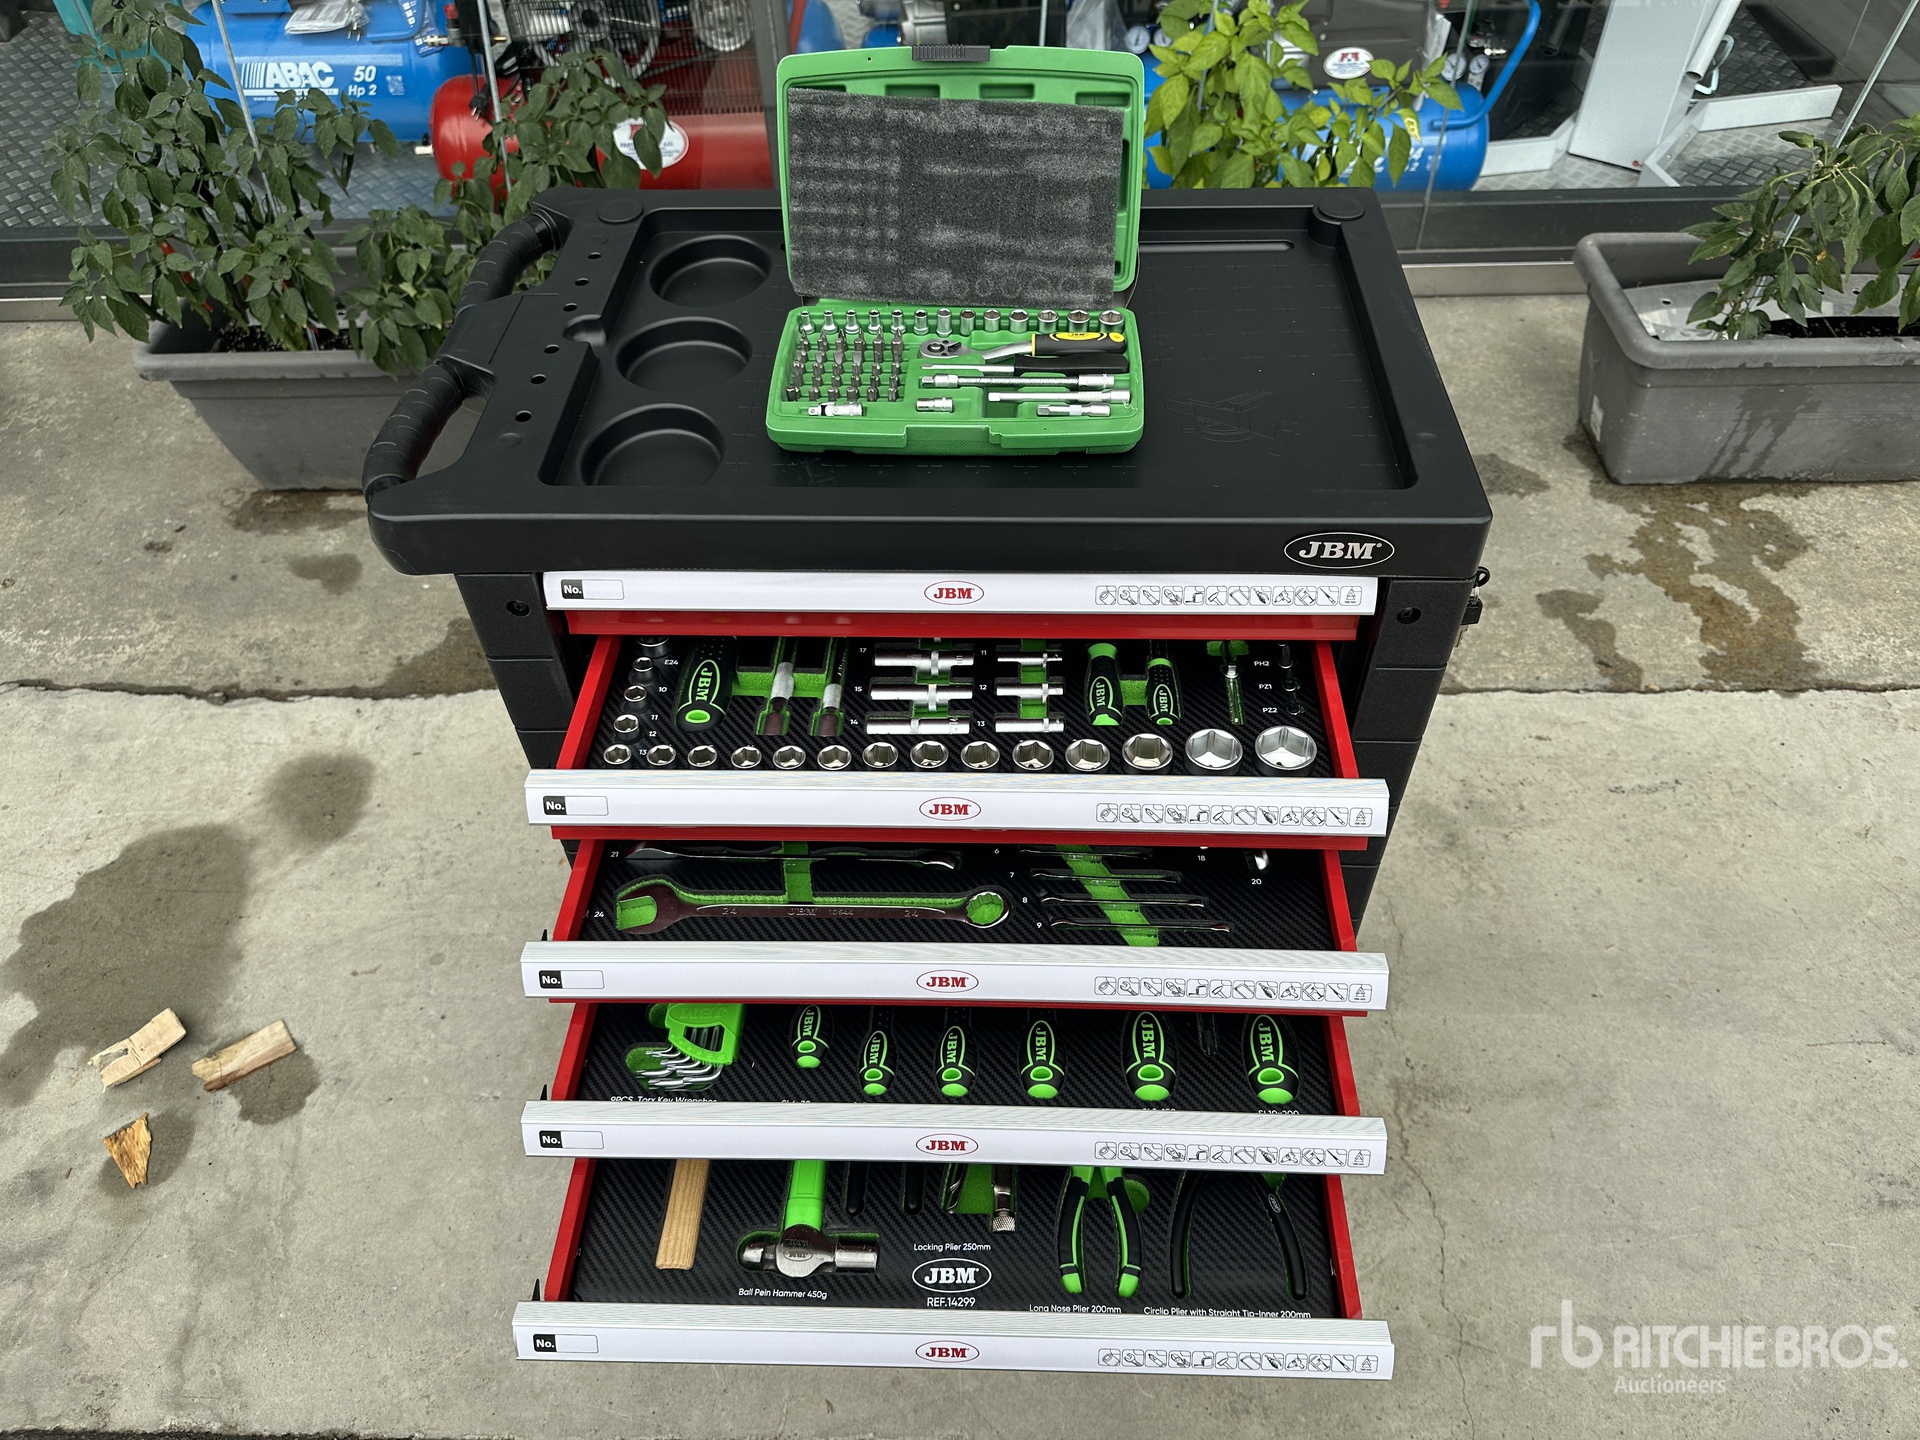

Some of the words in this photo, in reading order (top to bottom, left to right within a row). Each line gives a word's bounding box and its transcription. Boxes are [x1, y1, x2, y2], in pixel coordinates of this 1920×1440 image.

[265, 61, 335, 89] ABAC
[353, 65, 377, 83] 50
[348, 84, 365, 98] Hp
[368, 84, 377, 96] 2
[1298, 541, 1377, 560] JBM
[563, 584, 582, 594] No.
[933, 587, 973, 599] JBM
[695, 667, 713, 702] JBM
[1095, 681, 1106, 707] JBM
[1159, 689, 1169, 713] JBM
[545, 800, 565, 810] No.
[928, 803, 969, 815] JBM
[1021, 896, 1028, 904] 8
[1036, 921, 1042, 929] 9
[541, 975, 561, 984] No.
[925, 976, 967, 988] JBM
[802, 1008, 815, 1036] JBM
[1035, 1027, 1047, 1062] JBM
[1140, 1019, 1156, 1059] JBM
[1257, 1022, 1275, 1063] JBM
[869, 1036, 881, 1064] JBM
[947, 1032, 958, 1064] JBM
[541, 1135, 561, 1144] No.
[925, 1139, 966, 1151] JBM
[913, 1242, 943, 1253] Locking
[944, 1242, 961, 1251] Plier
[962, 1243, 991, 1251] 250mm
[923, 1267, 976, 1284] JBM
[738, 1288, 754, 1297] Ball
[754, 1288, 771, 1298] Pein
[772, 1289, 806, 1299] Hammer
[806, 1290, 828, 1300] 450g
[926, 1297, 976, 1307] REF.14299
[1029, 1304, 1049, 1312] Long
[1050, 1304, 1071, 1313] Nose
[1072, 1305, 1089, 1313] Plier
[1091, 1305, 1122, 1314] 200mm
[1143, 1306, 1170, 1316] Circlip
[1171, 1307, 1188, 1316] Plier
[1189, 1307, 1207, 1316] with
[1208, 1308, 1241, 1317] Straight
[1280, 1310, 1312, 1319] 200mm
[535, 1338, 555, 1348] No.
[925, 1346, 967, 1359] JBM
